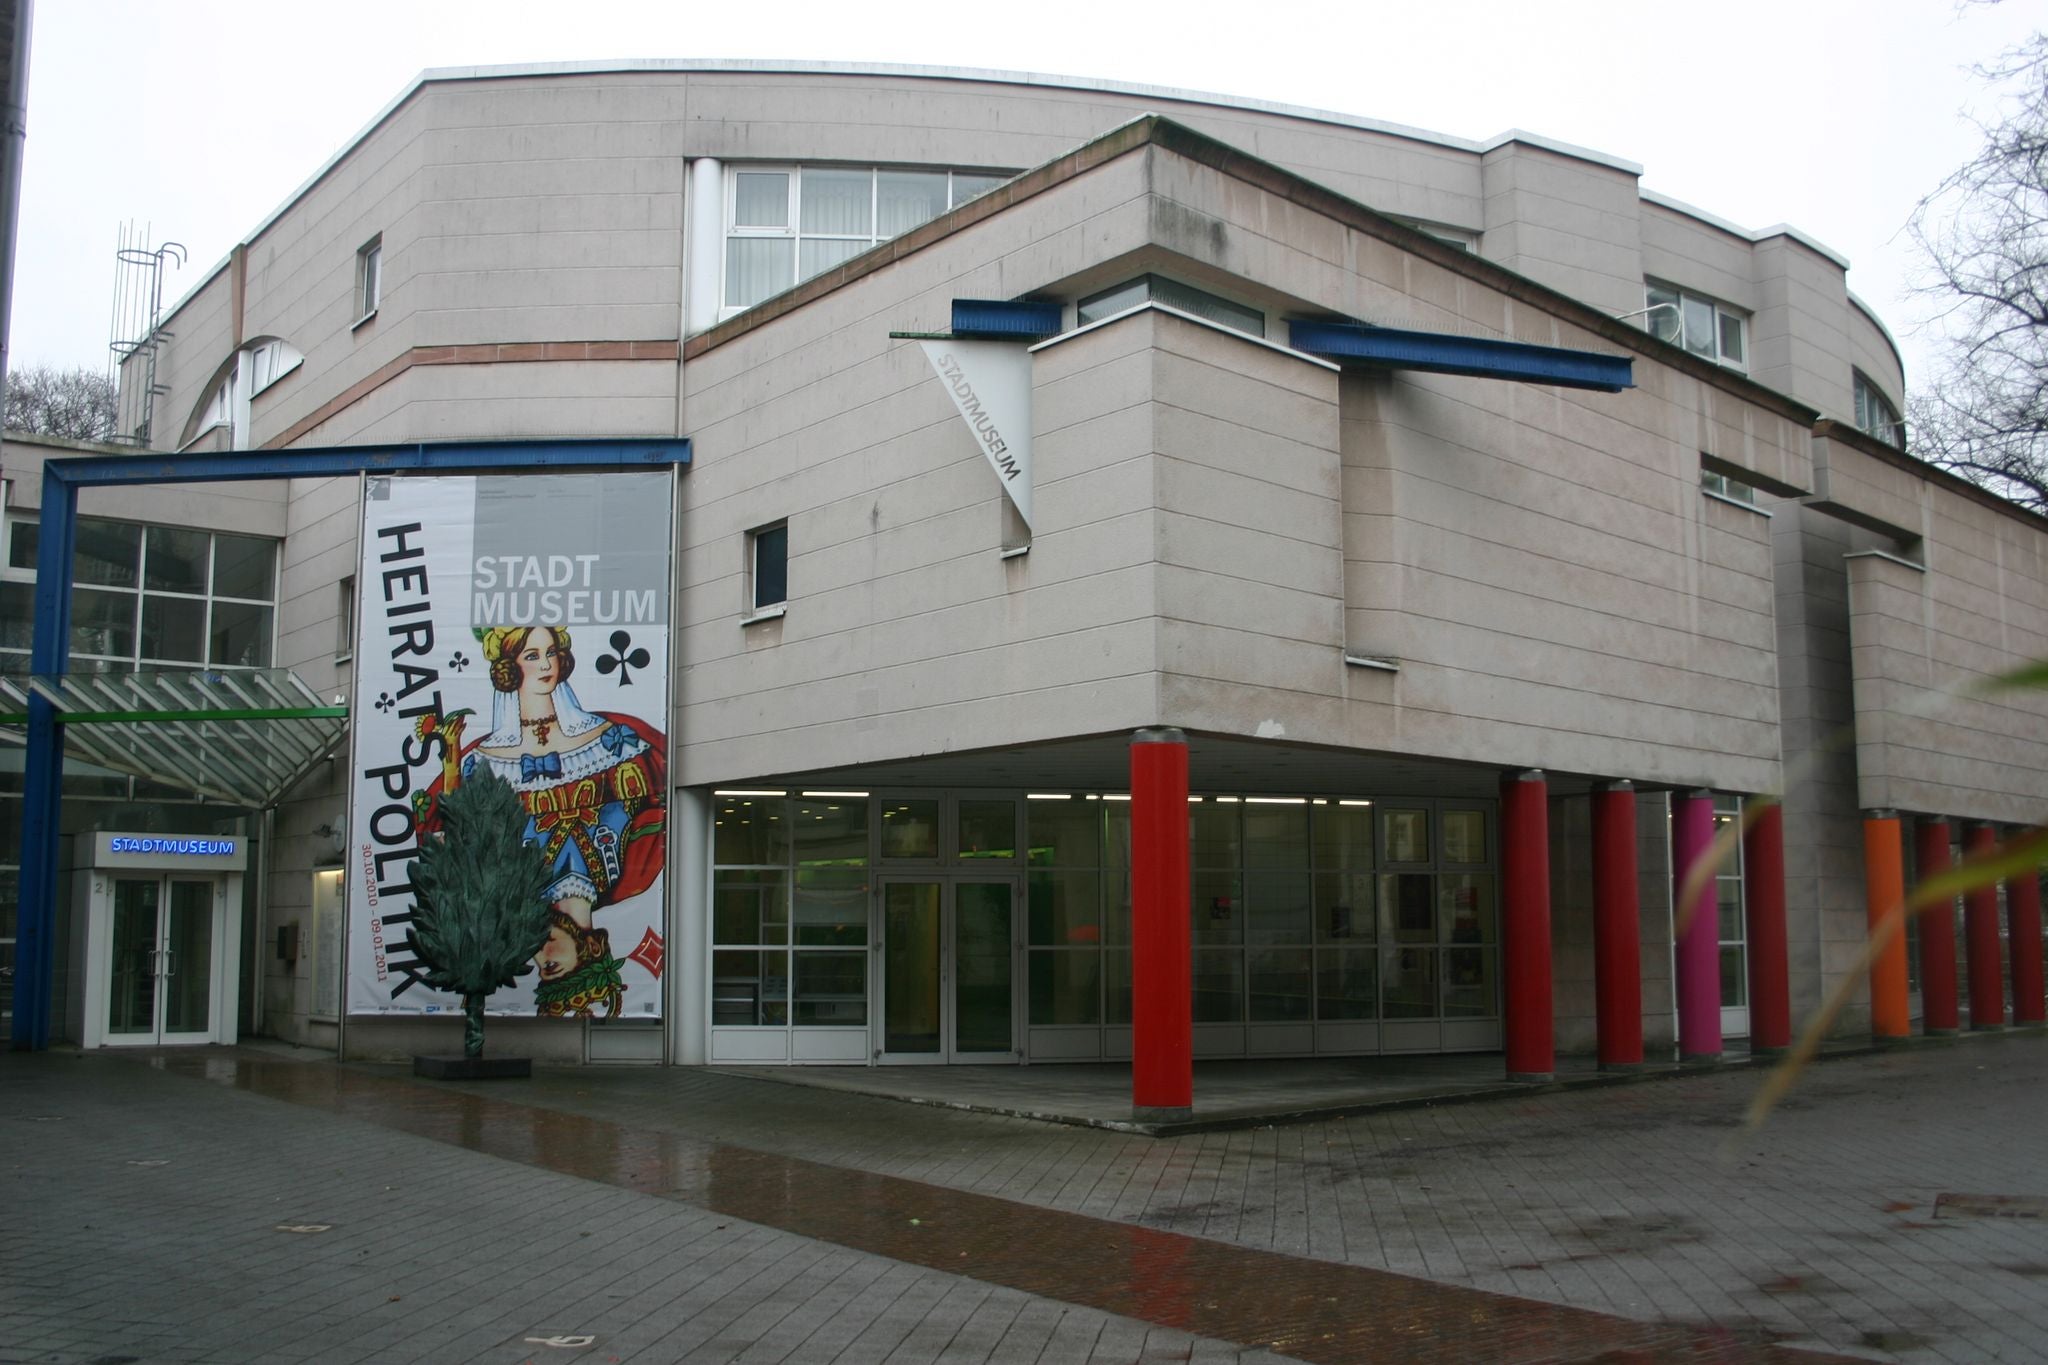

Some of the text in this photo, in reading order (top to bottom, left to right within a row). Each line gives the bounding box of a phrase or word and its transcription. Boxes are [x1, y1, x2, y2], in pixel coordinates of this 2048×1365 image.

[938, 353, 1021, 481] STADTMUSEUM
[474, 554, 600, 589] STADT
[473, 589, 656, 625] MUSEUM
[112, 837, 235, 854] STADTMUSEUM
[362, 844, 378, 907] 30.10.2010
[371, 918, 387, 982] 09.01.2011
